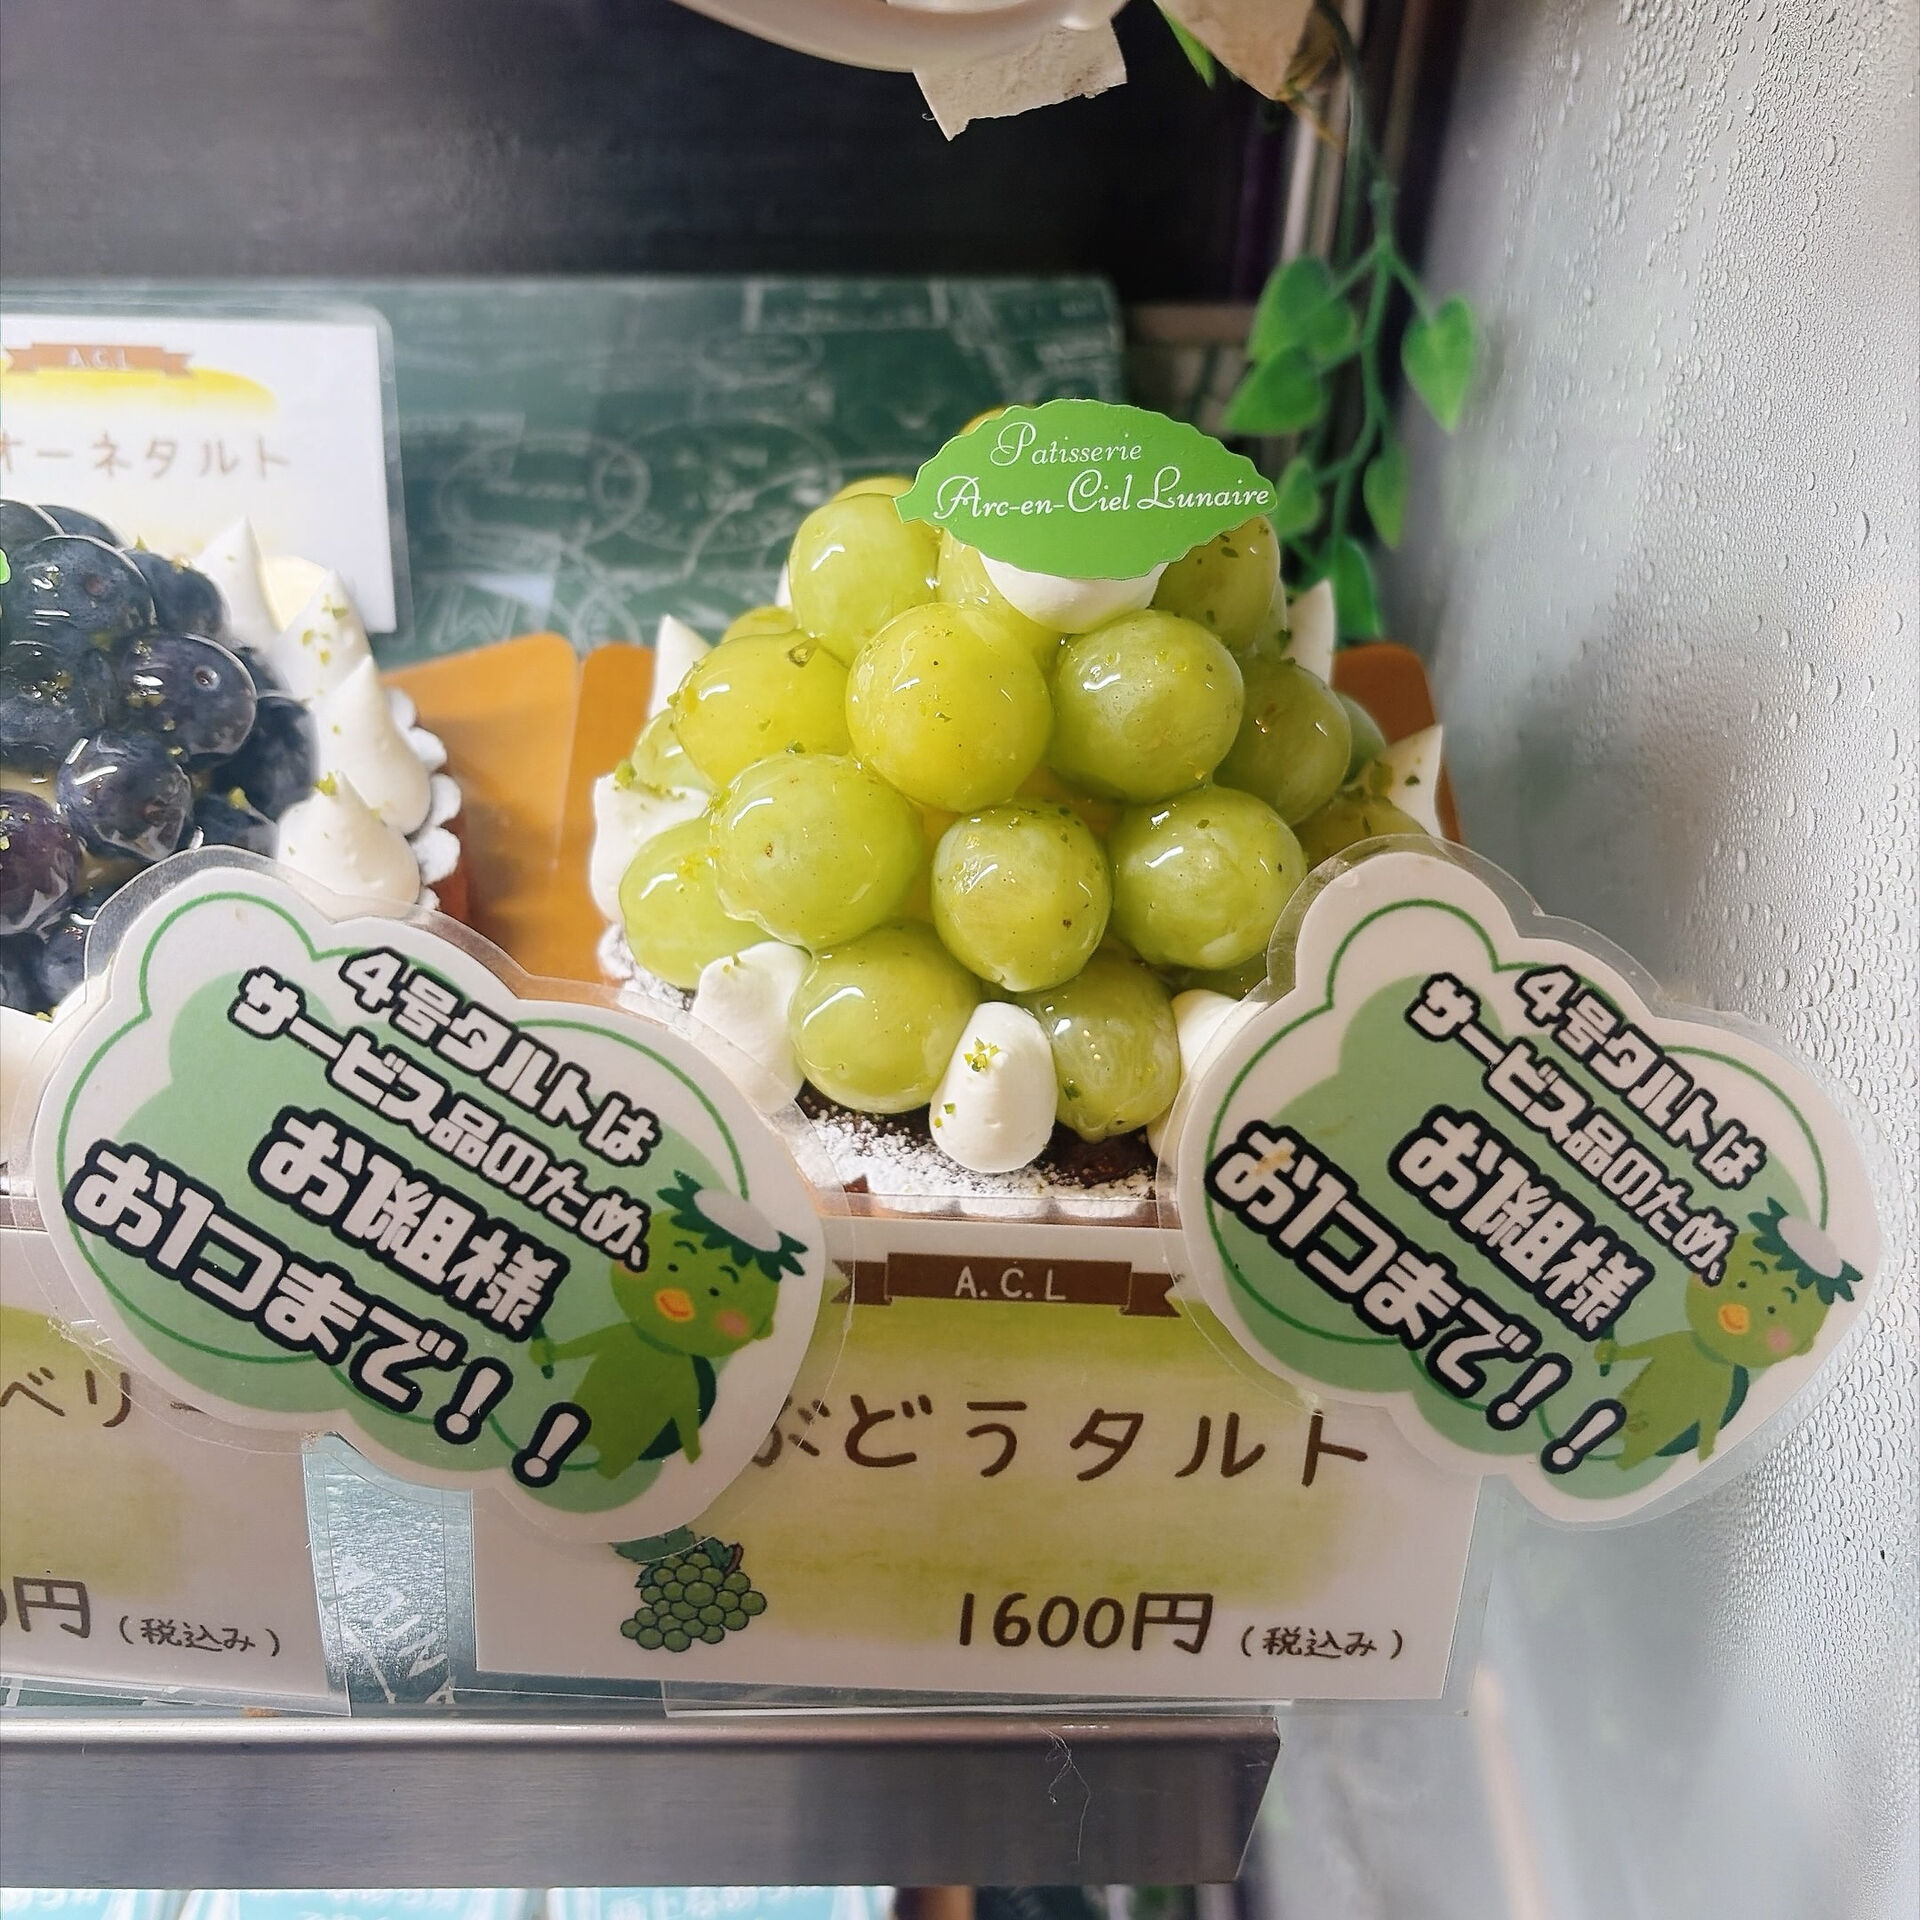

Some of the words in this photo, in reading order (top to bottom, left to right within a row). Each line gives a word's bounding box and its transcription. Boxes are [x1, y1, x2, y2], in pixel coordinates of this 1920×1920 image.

[932, 468, 1132, 520] Arc-en-Ciel
[1136, 466, 1270, 511] Lunaire
[989, 421, 1142, 467] Patisserie
[228, 966, 650, 1271] サービス品のため、
[339, 946, 662, 1167] 4号タルトは
[1405, 972, 1738, 1286] サービス品のため、
[1515, 965, 1767, 1190] 4号タルトは
[248, 1105, 570, 1342] お1組様
[955, 1265, 1067, 1302] A.C.L
[1387, 1104, 1656, 1341] お1組様
[0, 1576, 91, 1639] 円
[119, 1614, 281, 1657] （税込み）
[958, 1591, 1214, 1654] 1600円
[1239, 1624, 1405, 1660] （税込み）
